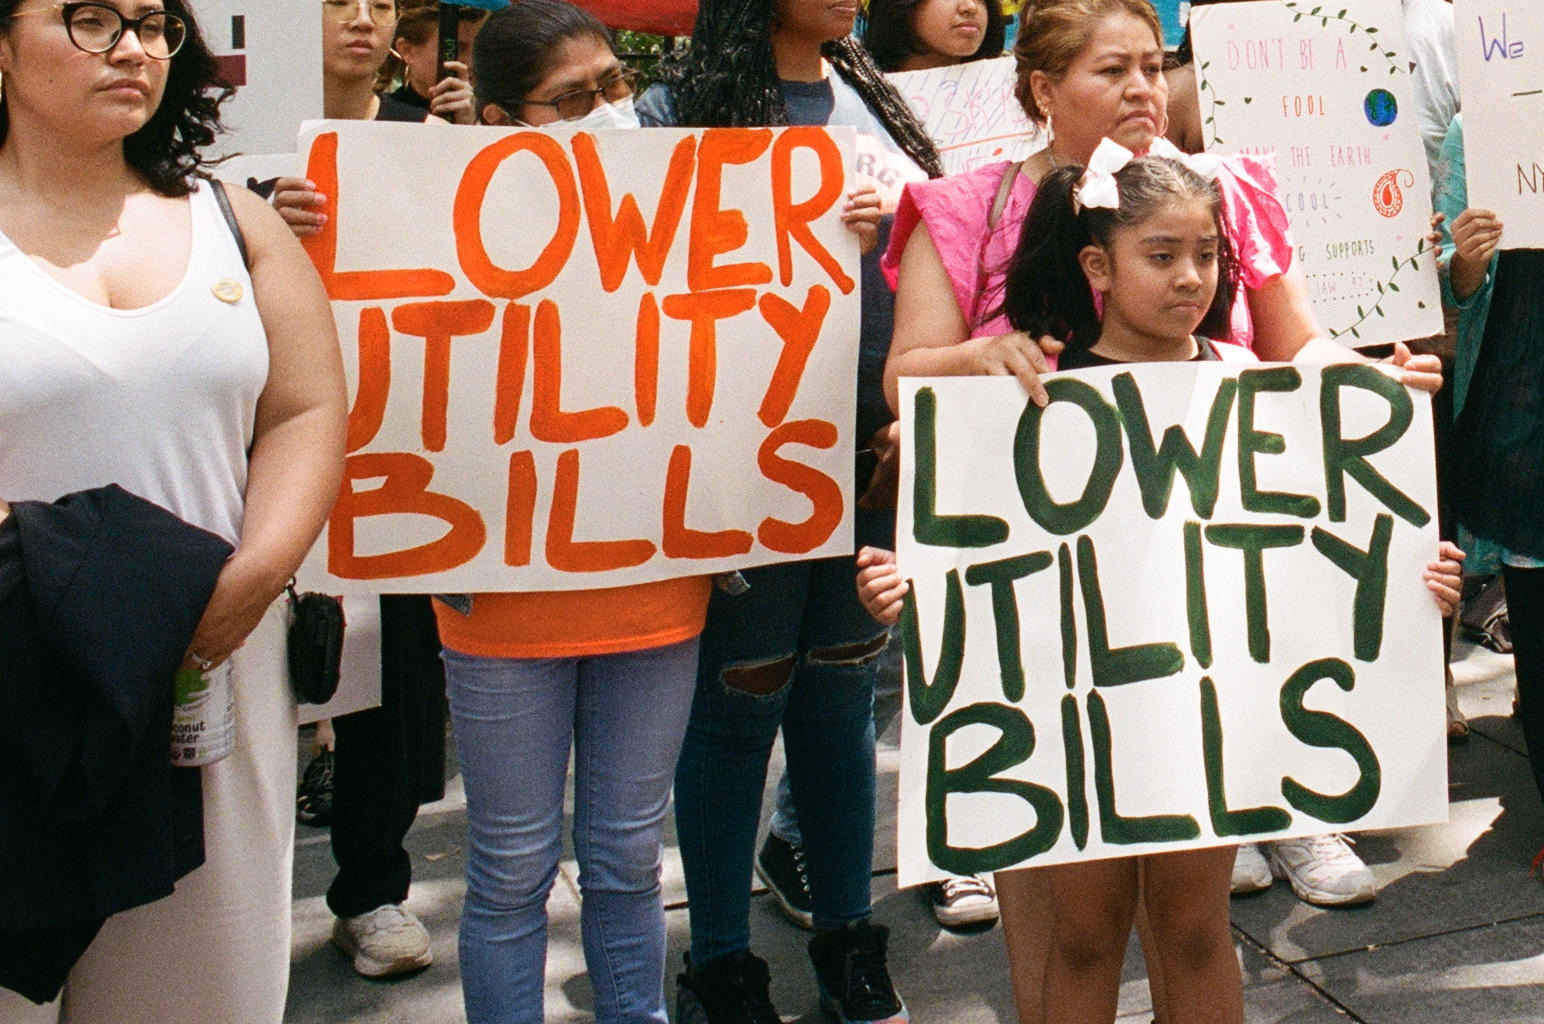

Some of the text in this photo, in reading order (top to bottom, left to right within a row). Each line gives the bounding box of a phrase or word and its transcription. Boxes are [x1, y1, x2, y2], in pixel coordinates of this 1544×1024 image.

[1227, 37, 1347, 71] DON'T BE A
[1478, 12, 1524, 62] We
[1283, 95, 1325, 117] FOOL
[1291, 145, 1312, 167] THE
[1330, 144, 1371, 167] EARTH
[300, 127, 855, 300] LOWER
[1285, 191, 1330, 212] COOL
[1325, 239, 1375, 261] SUPPORTS
[913, 364, 1431, 548] LOWER
[327, 419, 844, 580] BILLS
[902, 514, 1394, 726] UTILITY
[925, 657, 1382, 875] BILLS
